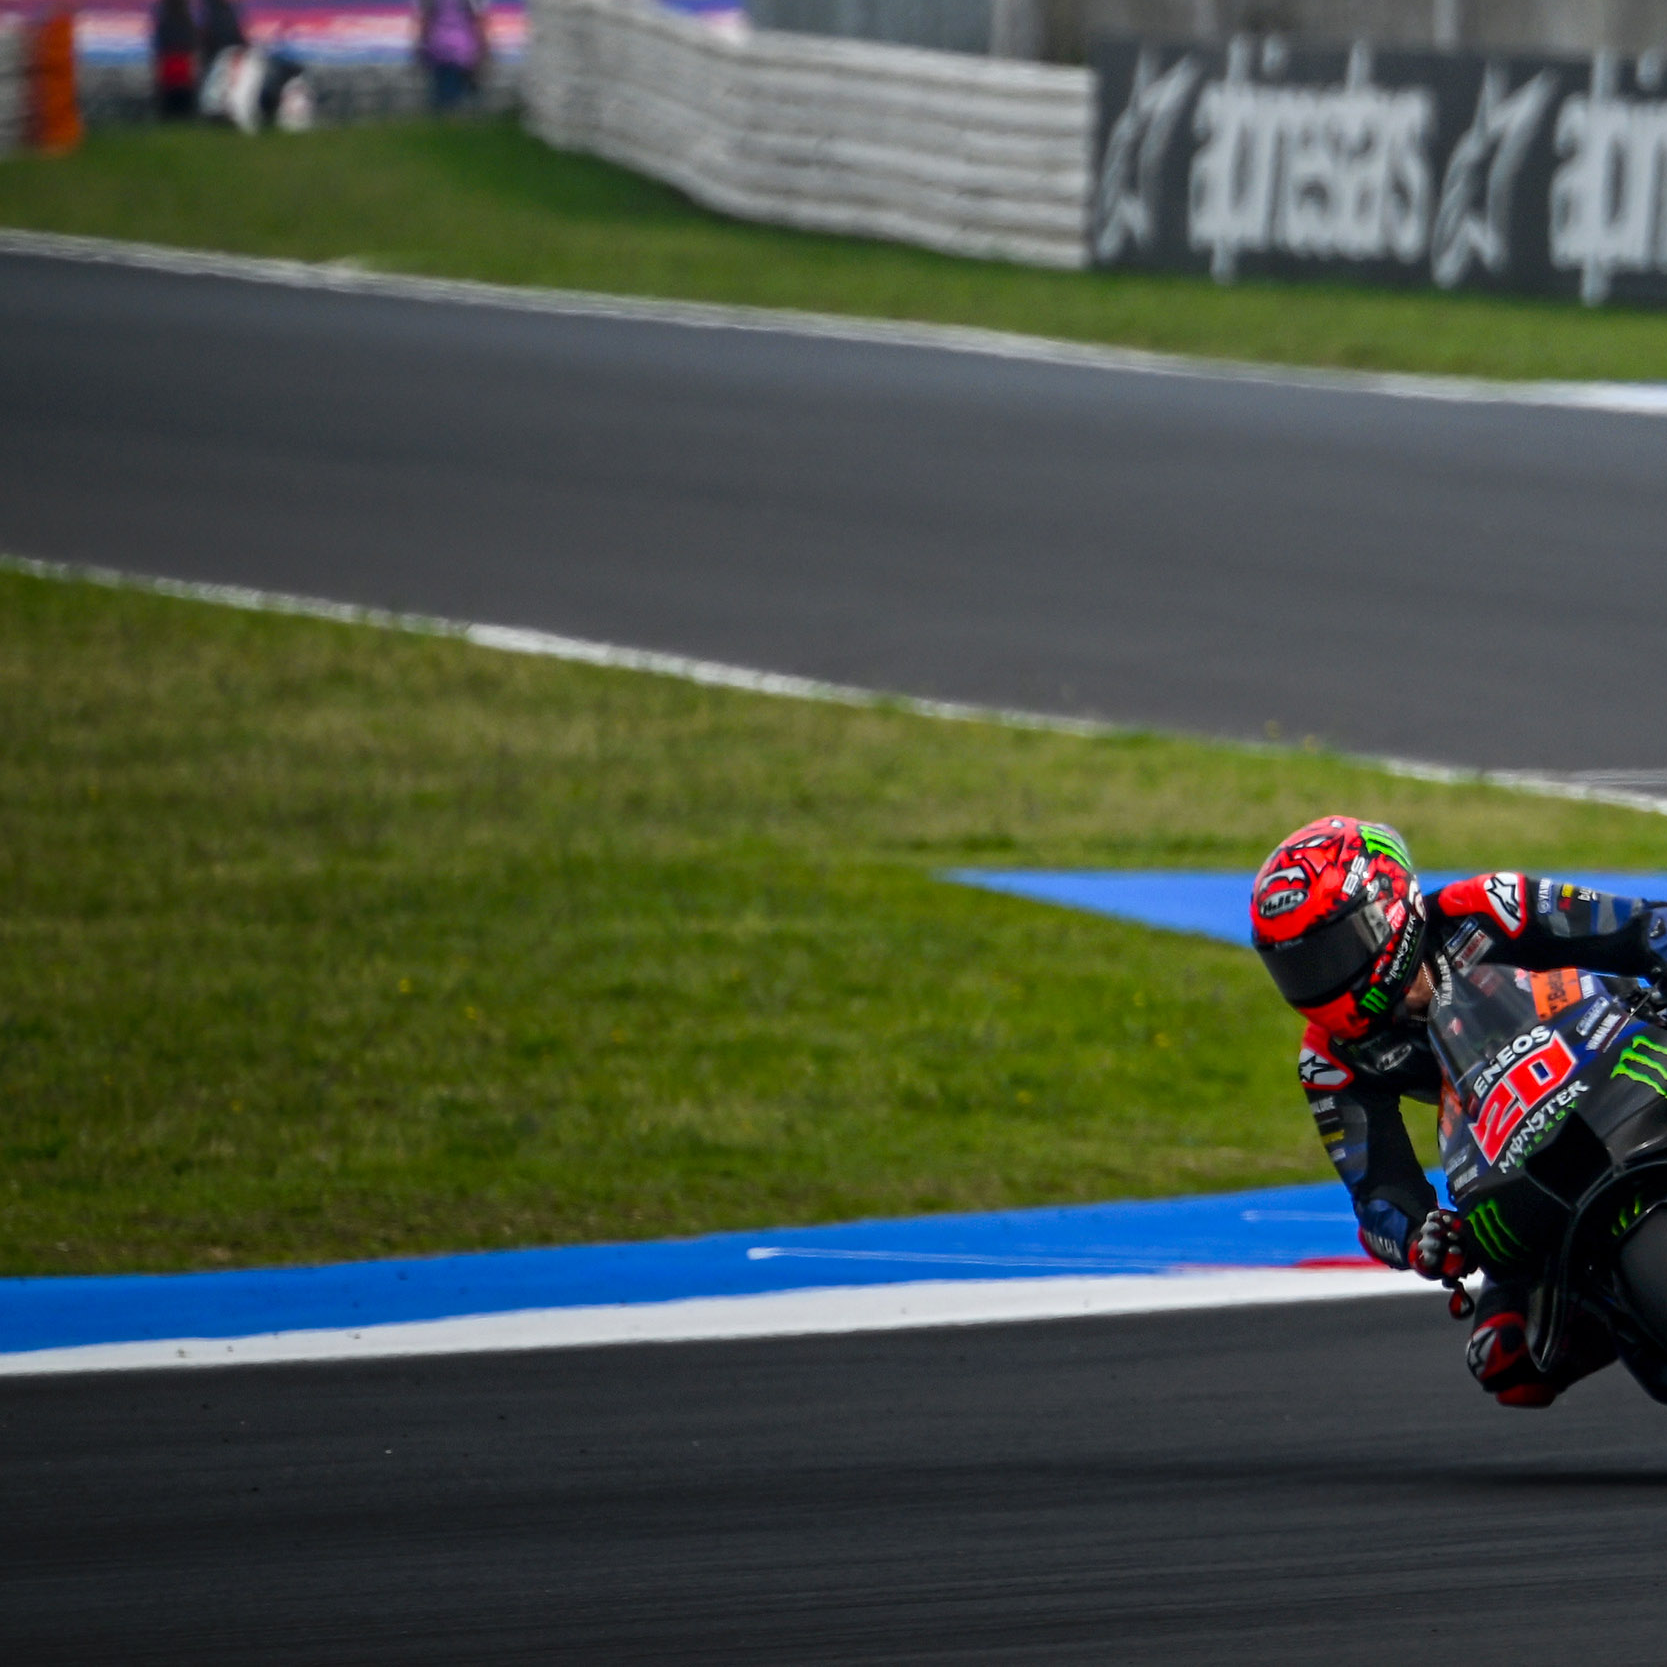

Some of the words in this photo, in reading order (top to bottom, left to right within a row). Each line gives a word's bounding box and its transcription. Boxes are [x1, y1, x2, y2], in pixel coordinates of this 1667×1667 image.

[1468, 1029, 1579, 1166] 20
[1473, 1025, 1550, 1098] ENEOS
[1499, 1079, 1591, 1174] MONSTER
